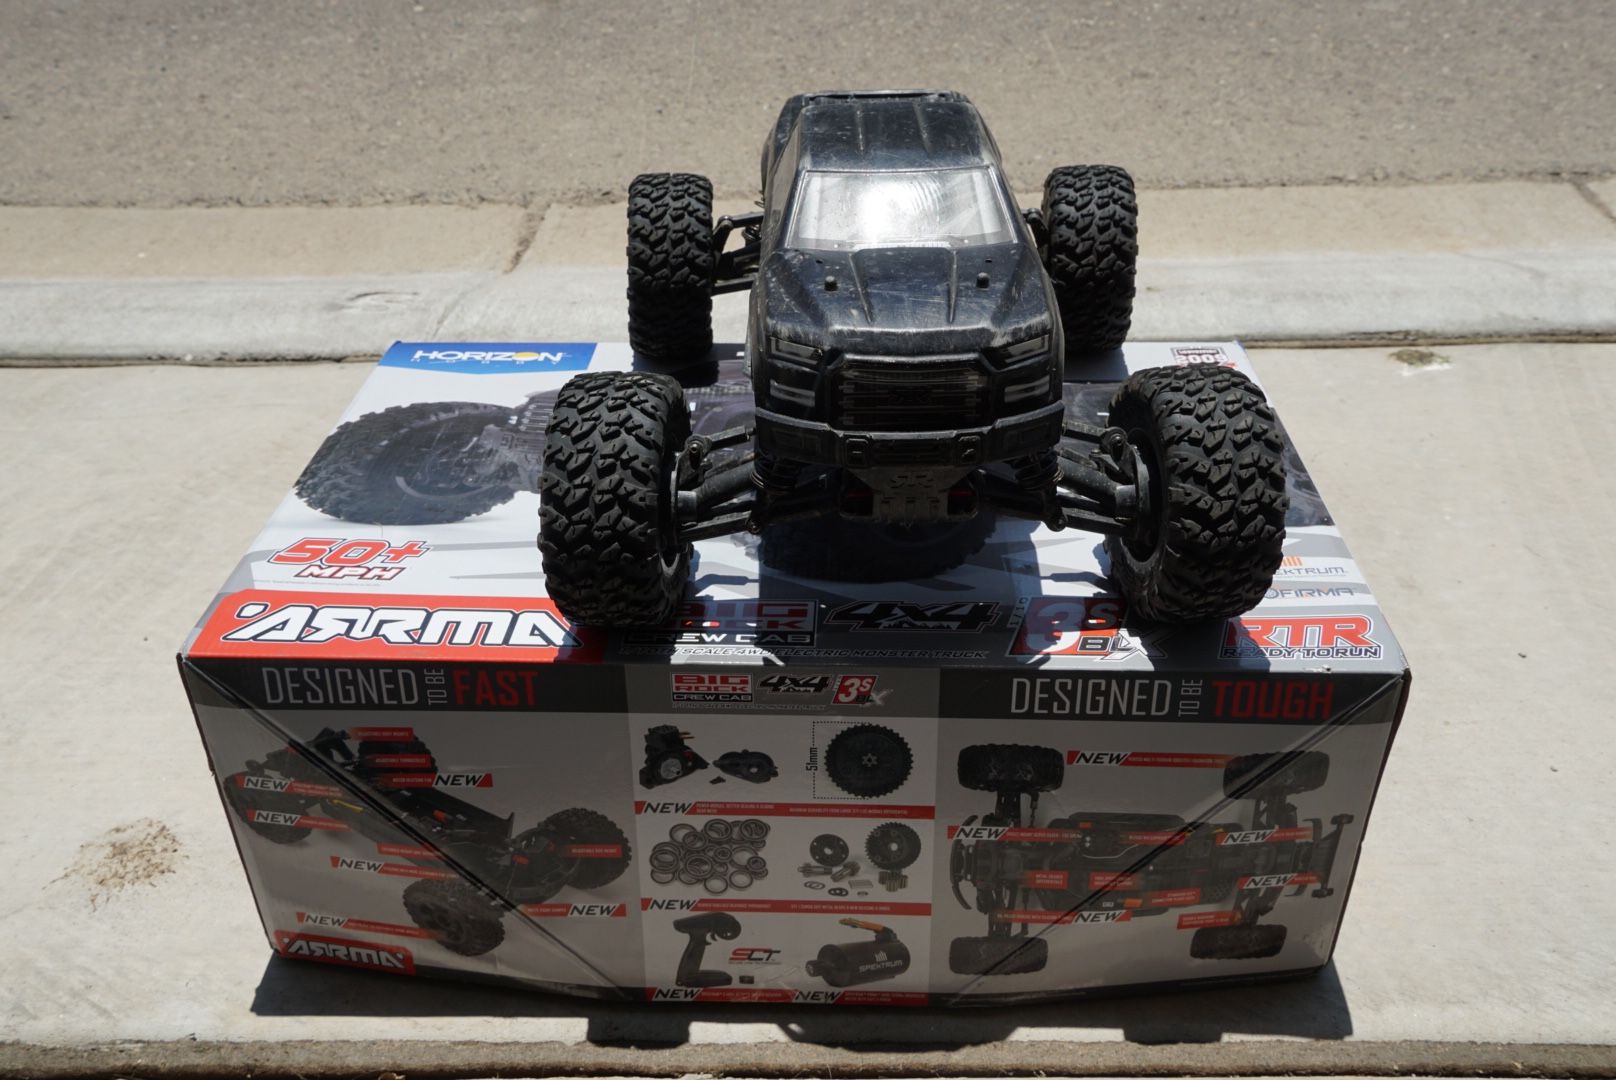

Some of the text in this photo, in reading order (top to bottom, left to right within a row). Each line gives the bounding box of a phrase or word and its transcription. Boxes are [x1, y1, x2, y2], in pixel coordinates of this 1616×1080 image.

[412, 349, 564, 362] HORIZON
[267, 537, 431, 567] 50+
[293, 564, 407, 581] MPH
[824, 601, 1000, 633] 4x4
[1225, 614, 1375, 648] RTR
[735, 634, 811, 644] CAB
[681, 647, 734, 656] SCALE
[775, 648, 851, 657] ELECTRIC
[851, 649, 931, 658] MONSTER
[933, 650, 989, 659] TRUCK
[1221, 646, 1381, 660] READY TO RUN
[262, 666, 539, 707] DESIGNED TO BE FAST
[673, 674, 832, 695] BIG 4x4
[673, 693, 753, 702] CREW CAB
[1010, 677, 1335, 721] DESIGNED TO BE TOUGH
[805, 746, 818, 772] 51mm
[1074, 752, 1126, 765] NEW
[244, 777, 288, 792] NEW
[434, 774, 482, 786] NEW
[644, 802, 692, 814] NEW
[255, 811, 298, 826] NEW
[955, 826, 1006, 839] NEW
[1224, 830, 1273, 843] NEW
[339, 858, 382, 872] NEW
[1246, 875, 1293, 887] NEW
[570, 905, 617, 917] NEW
[649, 899, 696, 911] NEW
[305, 913, 347, 928] NEW
[1075, 911, 1122, 924] NEW
[728, 947, 782, 962] SCT
[654, 988, 701, 1001] NEW
[794, 990, 841, 1003] NEW
